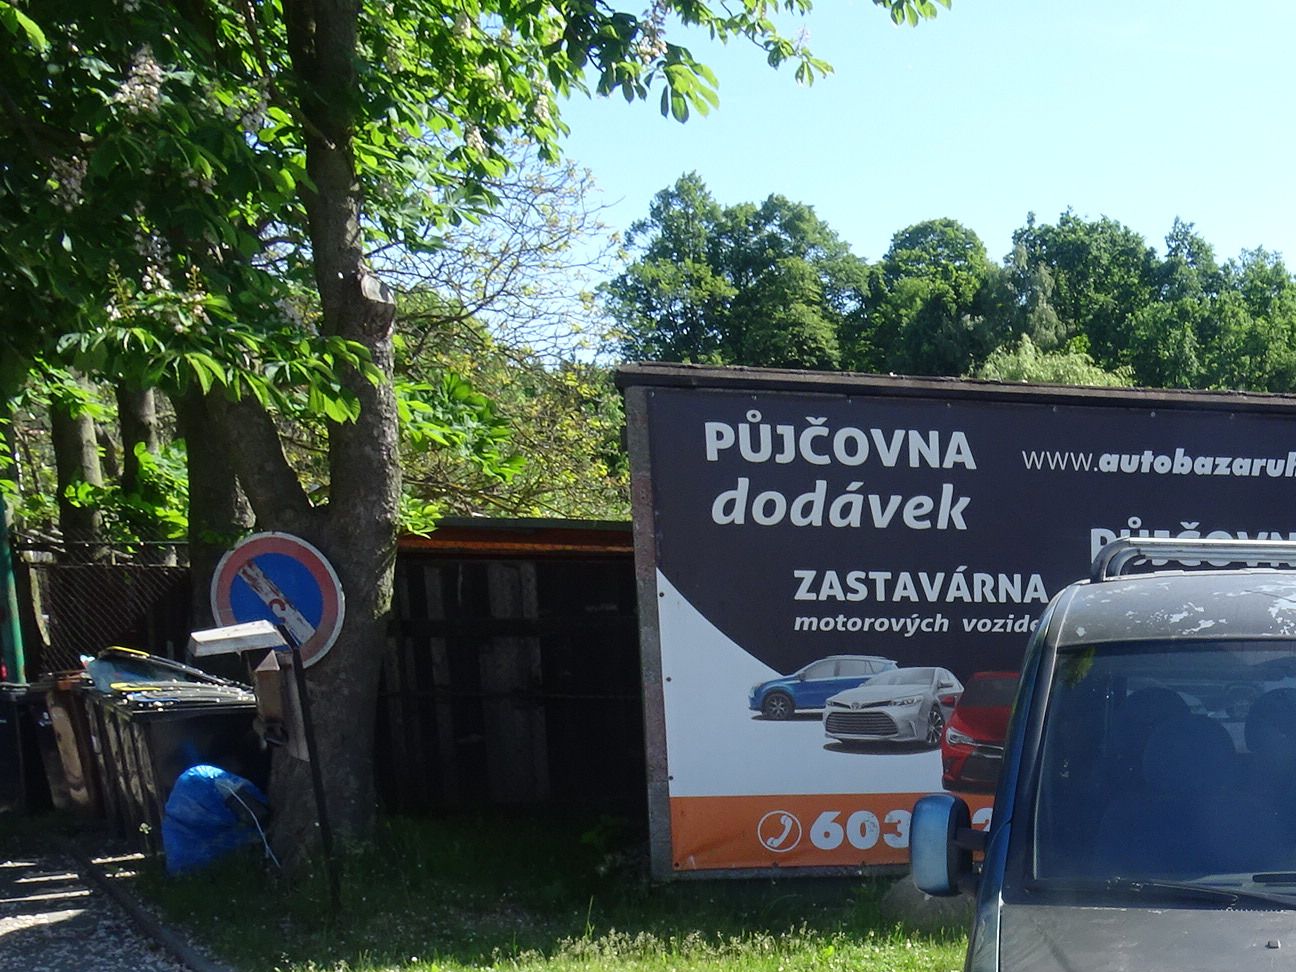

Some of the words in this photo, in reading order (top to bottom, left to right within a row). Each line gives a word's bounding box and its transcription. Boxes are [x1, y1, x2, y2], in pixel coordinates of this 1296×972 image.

[704, 409, 978, 470] PŮJČOVNA
[711, 477, 972, 530] dodávek
[793, 565, 1050, 603] ZASTAVÁRNA
[793, 613, 950, 637] motorových
